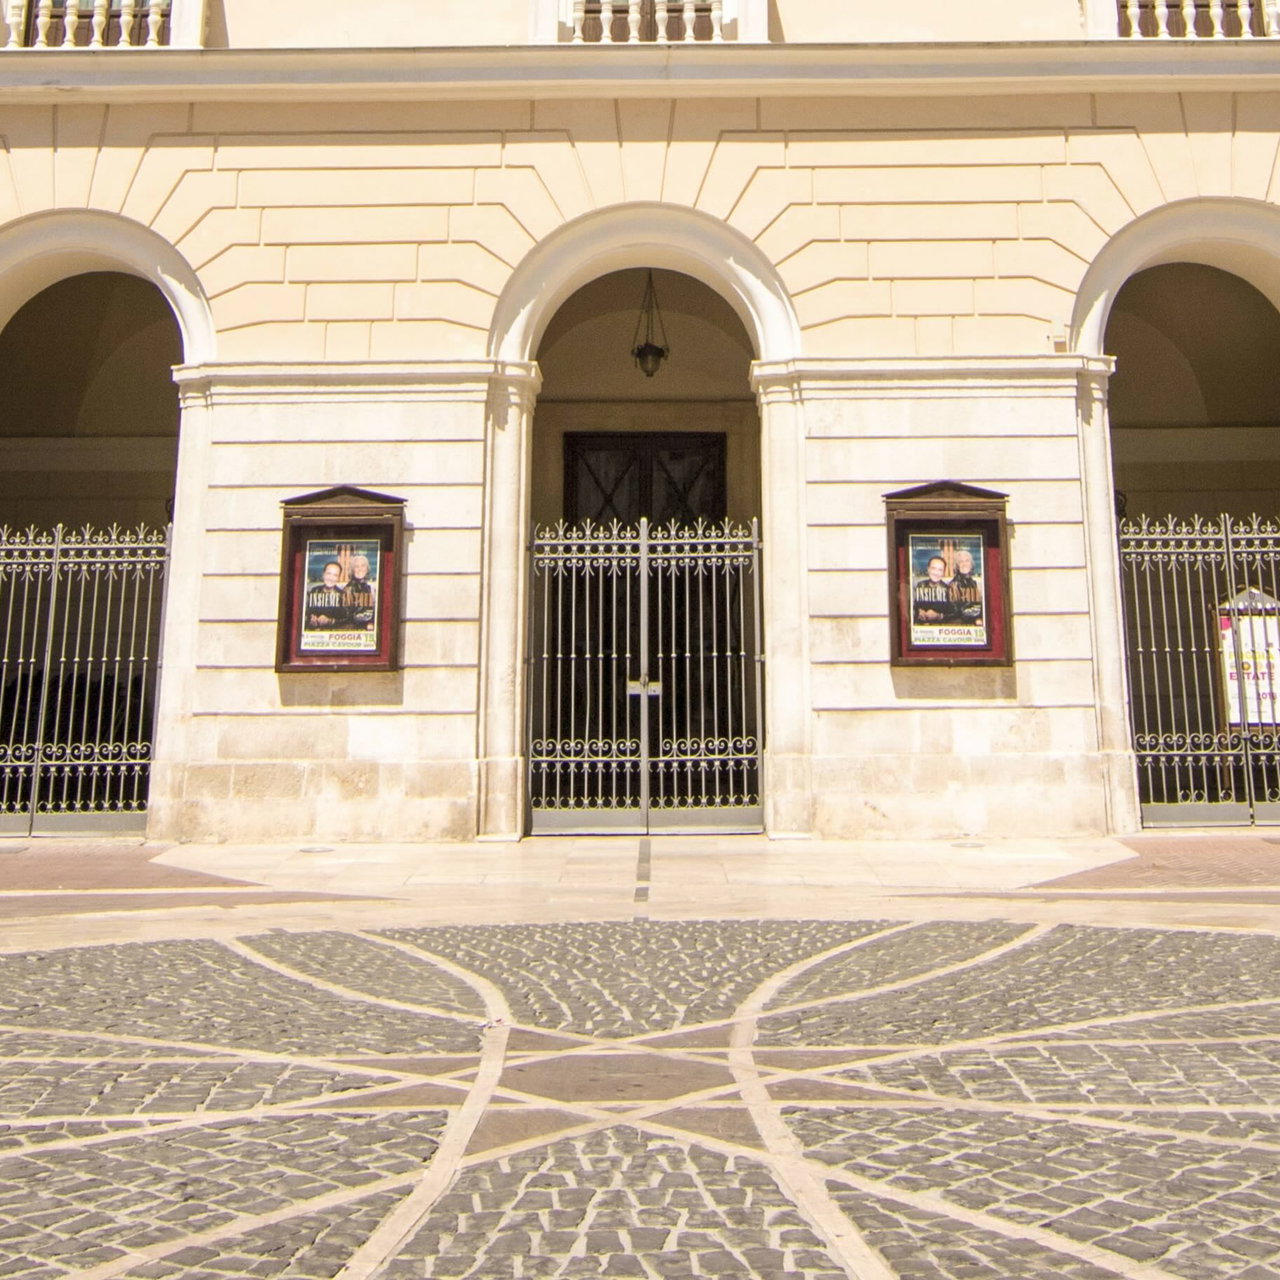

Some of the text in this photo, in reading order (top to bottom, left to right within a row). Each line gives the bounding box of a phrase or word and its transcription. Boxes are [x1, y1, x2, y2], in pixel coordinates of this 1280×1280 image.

[309, 592, 340, 607] INSIEME
[916, 587, 947, 602] INSIEME
[1229, 651, 1275, 660] FGGIA
[1229, 672, 1275, 680] ETATE
